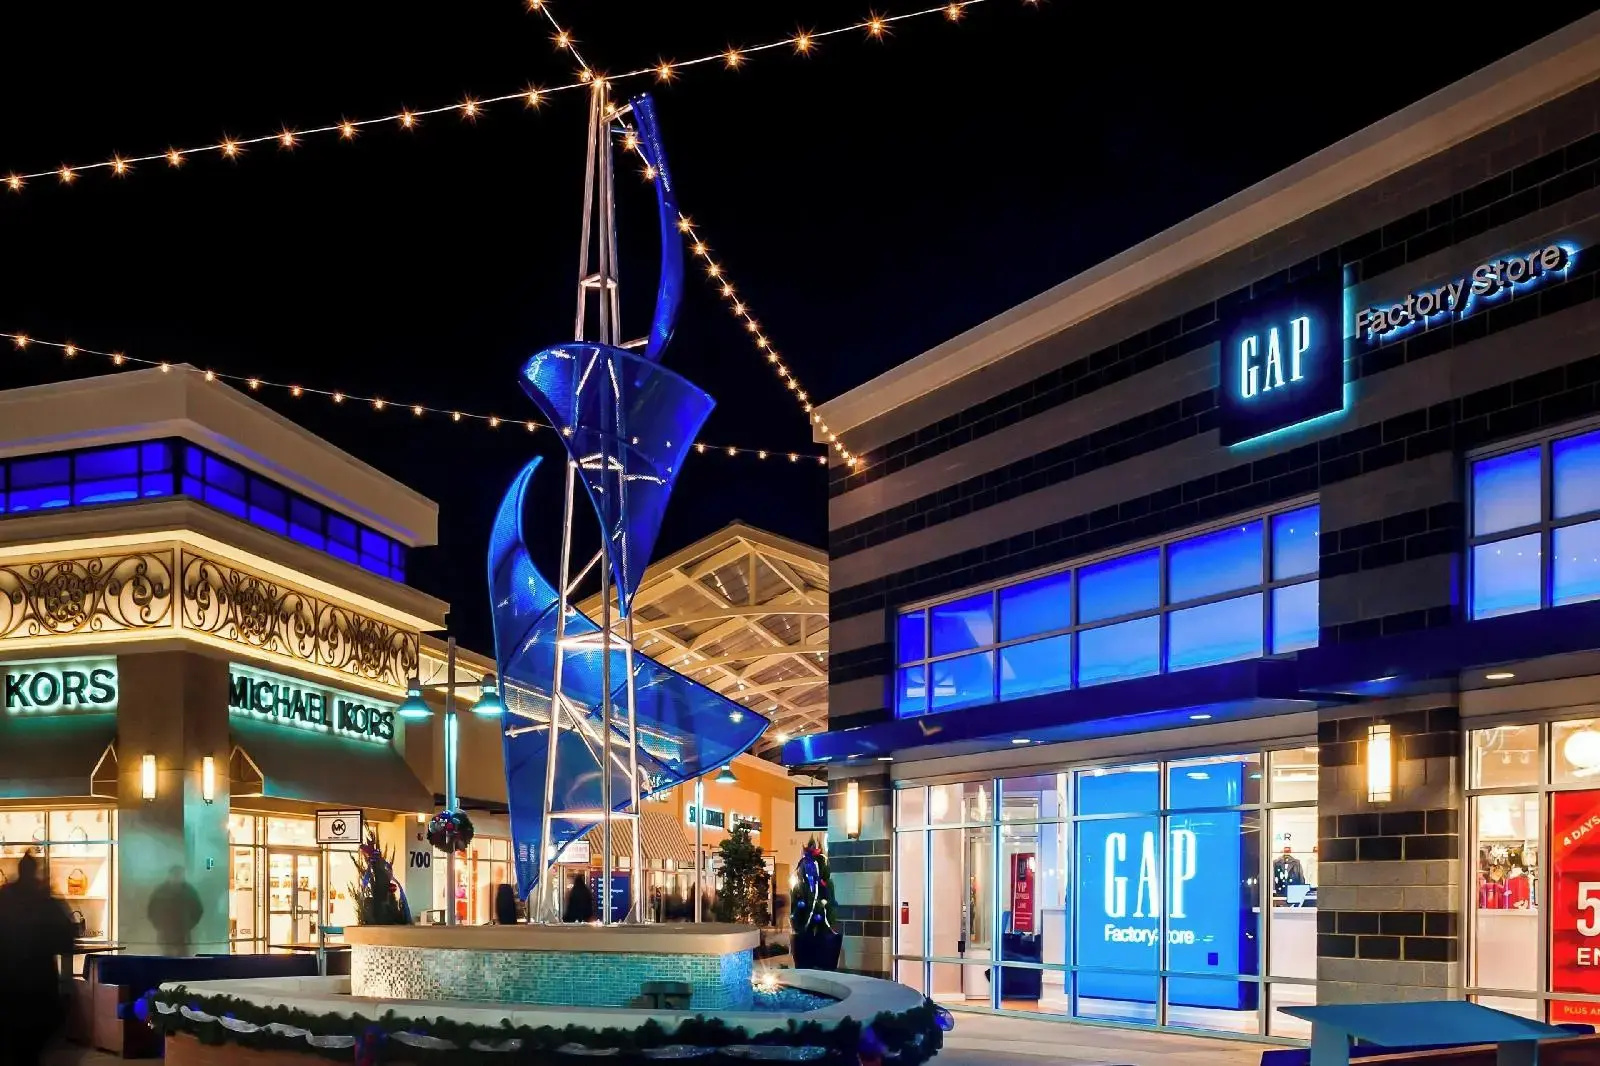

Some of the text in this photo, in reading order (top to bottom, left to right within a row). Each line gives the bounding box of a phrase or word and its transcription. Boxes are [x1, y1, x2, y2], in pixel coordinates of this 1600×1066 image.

[1355, 244, 1561, 339] Factory Store
[1241, 316, 1311, 399] GAP
[5, 668, 116, 708] KORS
[229, 673, 395, 740] MICHAEL KORS
[1563, 815, 1600, 846] 4 DAYS
[409, 851, 431, 868] 700
[1104, 829, 1197, 919] GAP
[1104, 923, 1156, 947] Factory
[1564, 1004, 1588, 1016] PLUS
